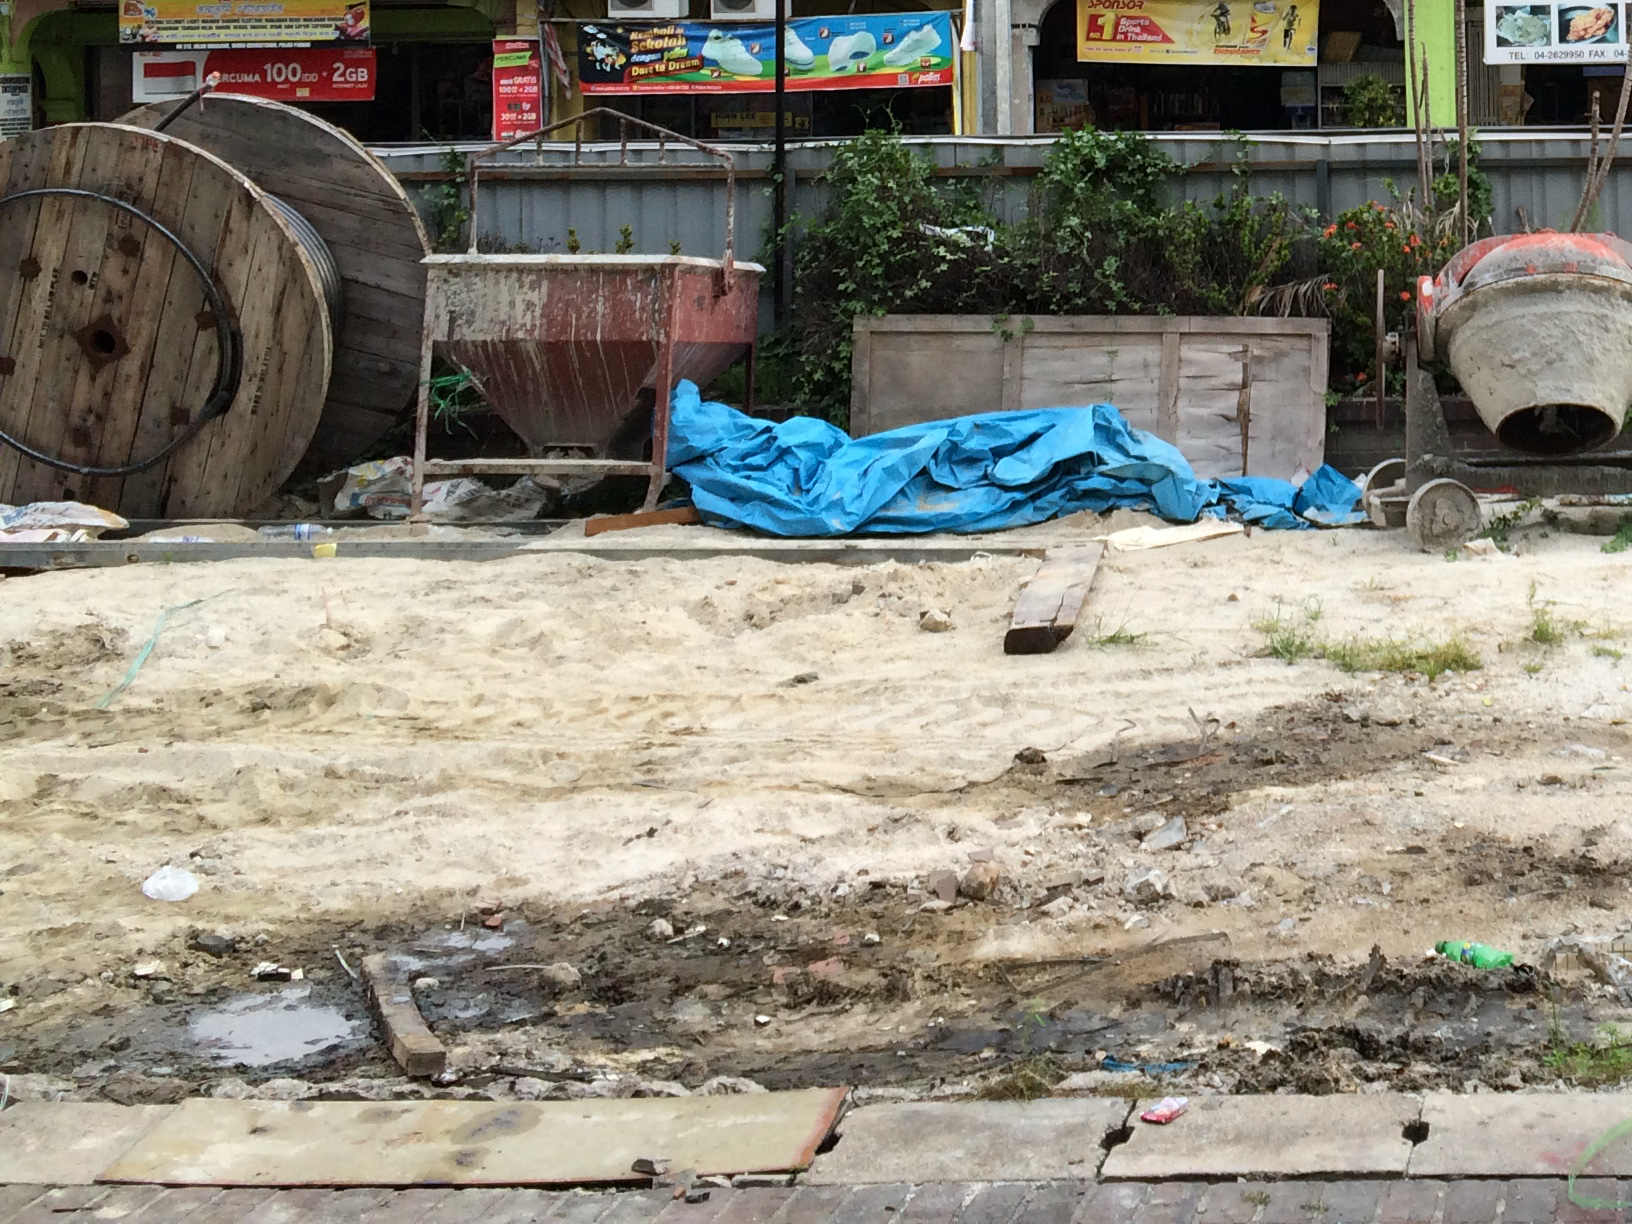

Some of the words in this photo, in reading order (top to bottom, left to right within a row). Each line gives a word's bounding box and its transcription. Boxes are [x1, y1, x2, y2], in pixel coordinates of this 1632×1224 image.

[1087, 0, 1144, 11] SPONSOR
[1534, 50, 1585, 60] 04-2629950
[215, 74, 261, 83] ERCUMA
[264, 62, 302, 82] 100
[332, 62, 369, 82] 2GB
[631, 65, 653, 77] Dare
[654, 61, 666, 73] to
[668, 58, 700, 71] Dream
